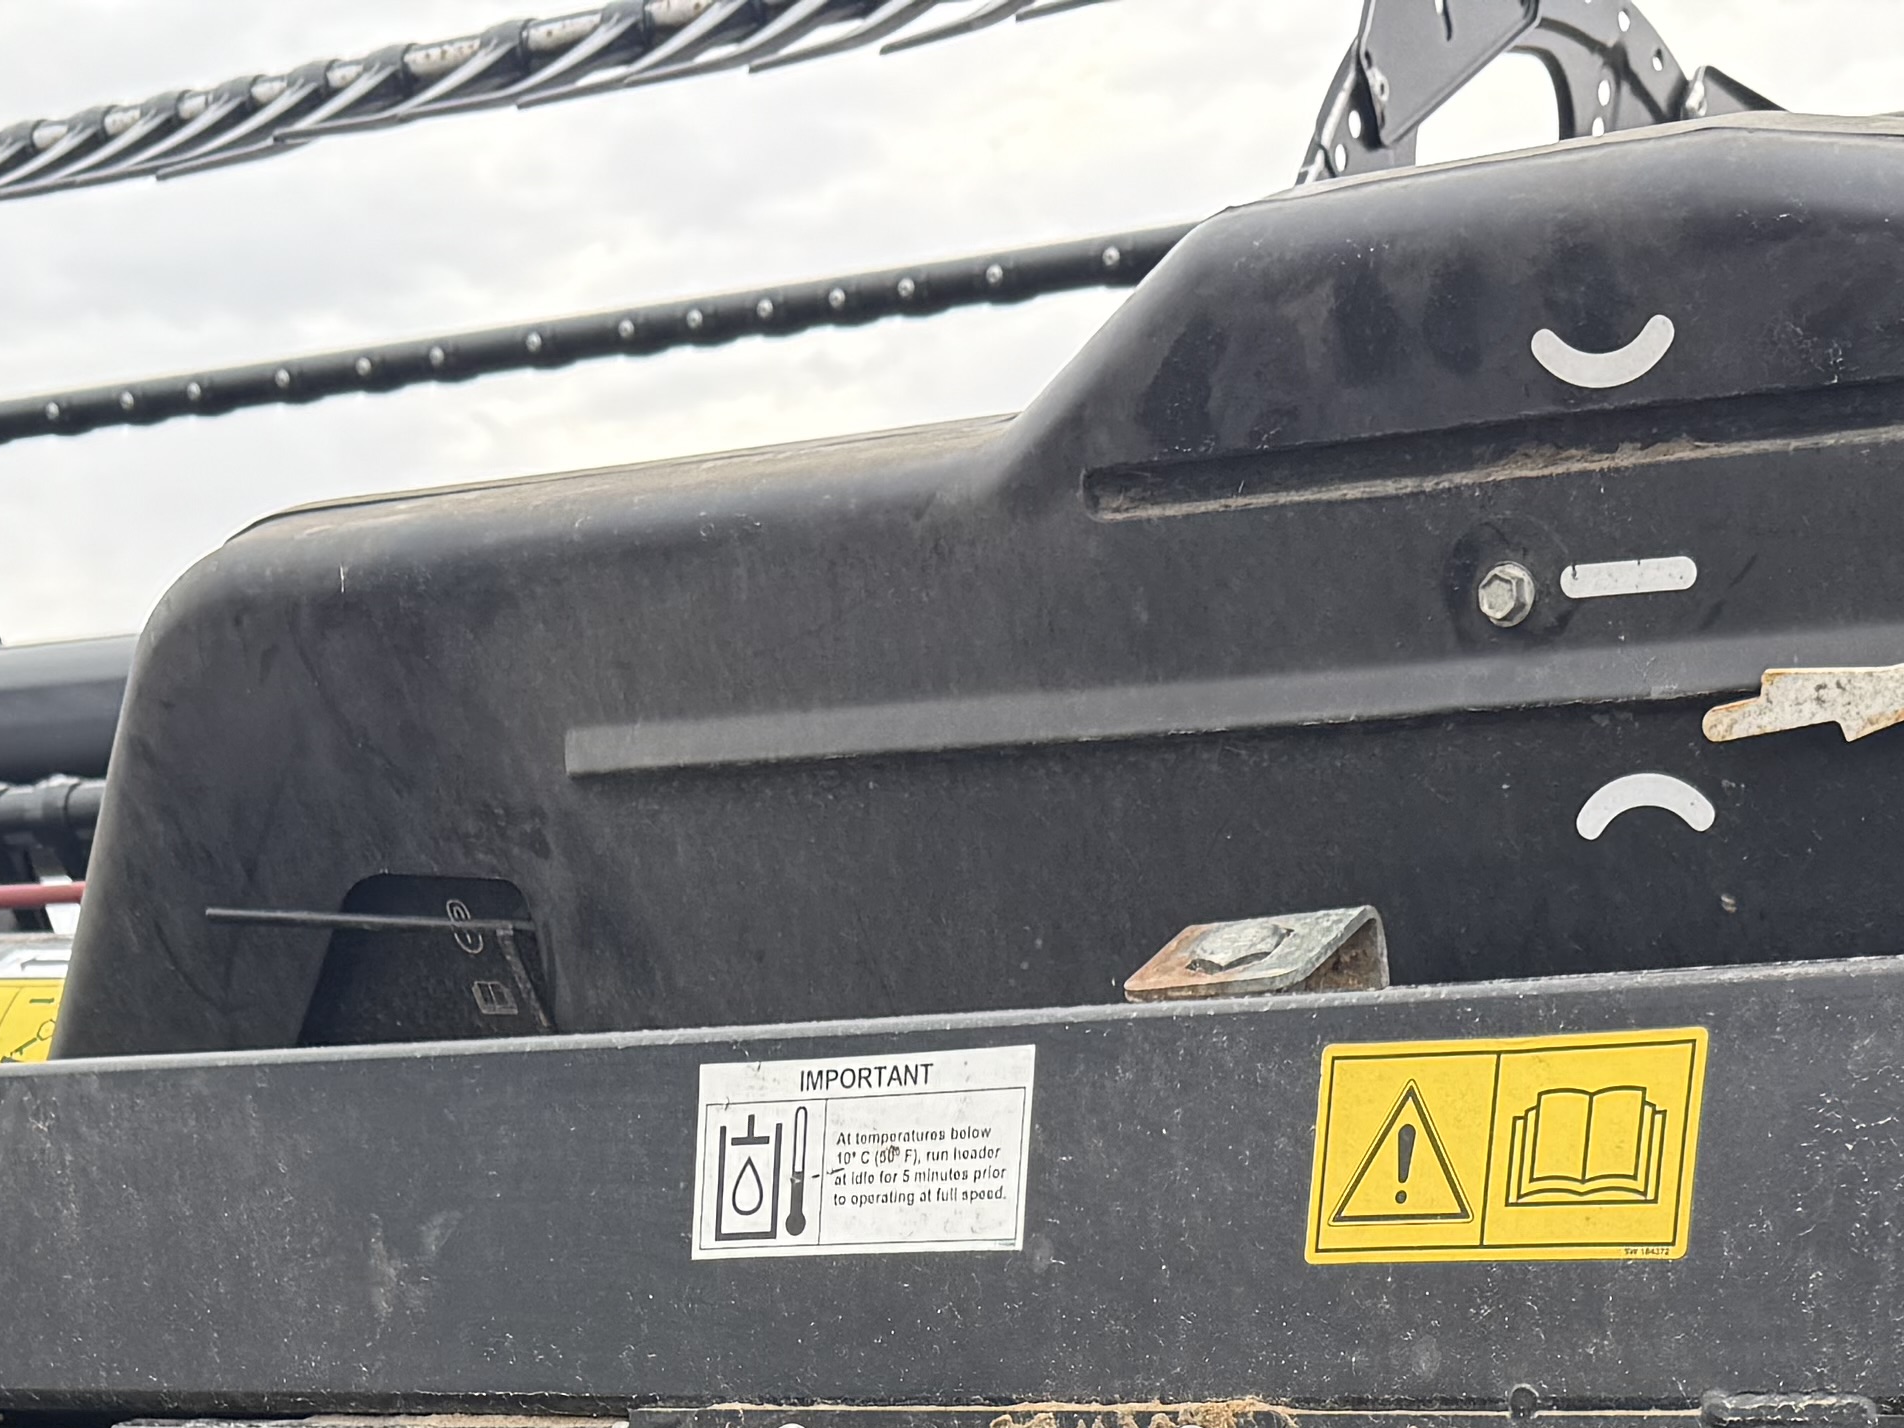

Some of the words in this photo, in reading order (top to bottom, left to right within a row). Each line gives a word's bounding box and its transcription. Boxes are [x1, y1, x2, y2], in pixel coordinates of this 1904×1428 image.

[799, 1062, 935, 1093] IMPORTANT
[836, 1131, 852, 1146] At
[855, 1128, 946, 1147] temperatures
[950, 1125, 992, 1140] below
[860, 1150, 870, 1165] C
[926, 1149, 949, 1162] run
[953, 1145, 1001, 1161] header
[834, 1173, 847, 1187] at
[851, 1170, 875, 1186] idle
[879, 1170, 898, 1184] for
[902, 1169, 911, 1183] 5
[914, 1167, 969, 1183] minutes
[973, 1164, 1007, 1184] prior
[833, 1192, 847, 1207] to
[850, 1190, 915, 1209] operating
[919, 1188, 932, 1203] at
[936, 1186, 959, 1203] full
[961, 1184, 1007, 1205] speed.
